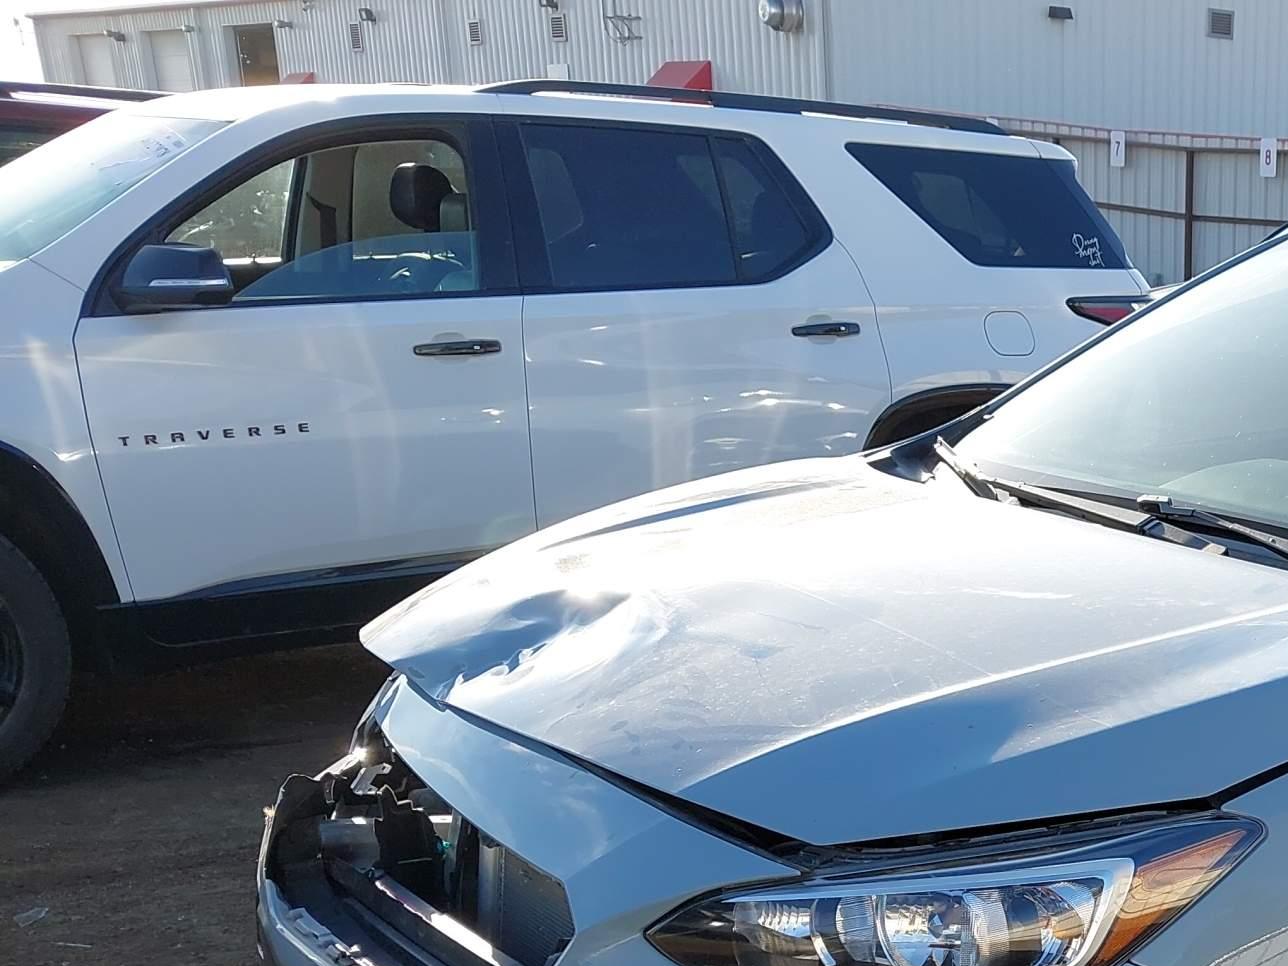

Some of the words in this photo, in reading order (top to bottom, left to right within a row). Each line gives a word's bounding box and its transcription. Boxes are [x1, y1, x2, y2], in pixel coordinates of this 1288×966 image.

[1115, 140, 1121, 157] 7
[1265, 149, 1271, 166] 8
[118, 422, 310, 447] TRAVERSE
